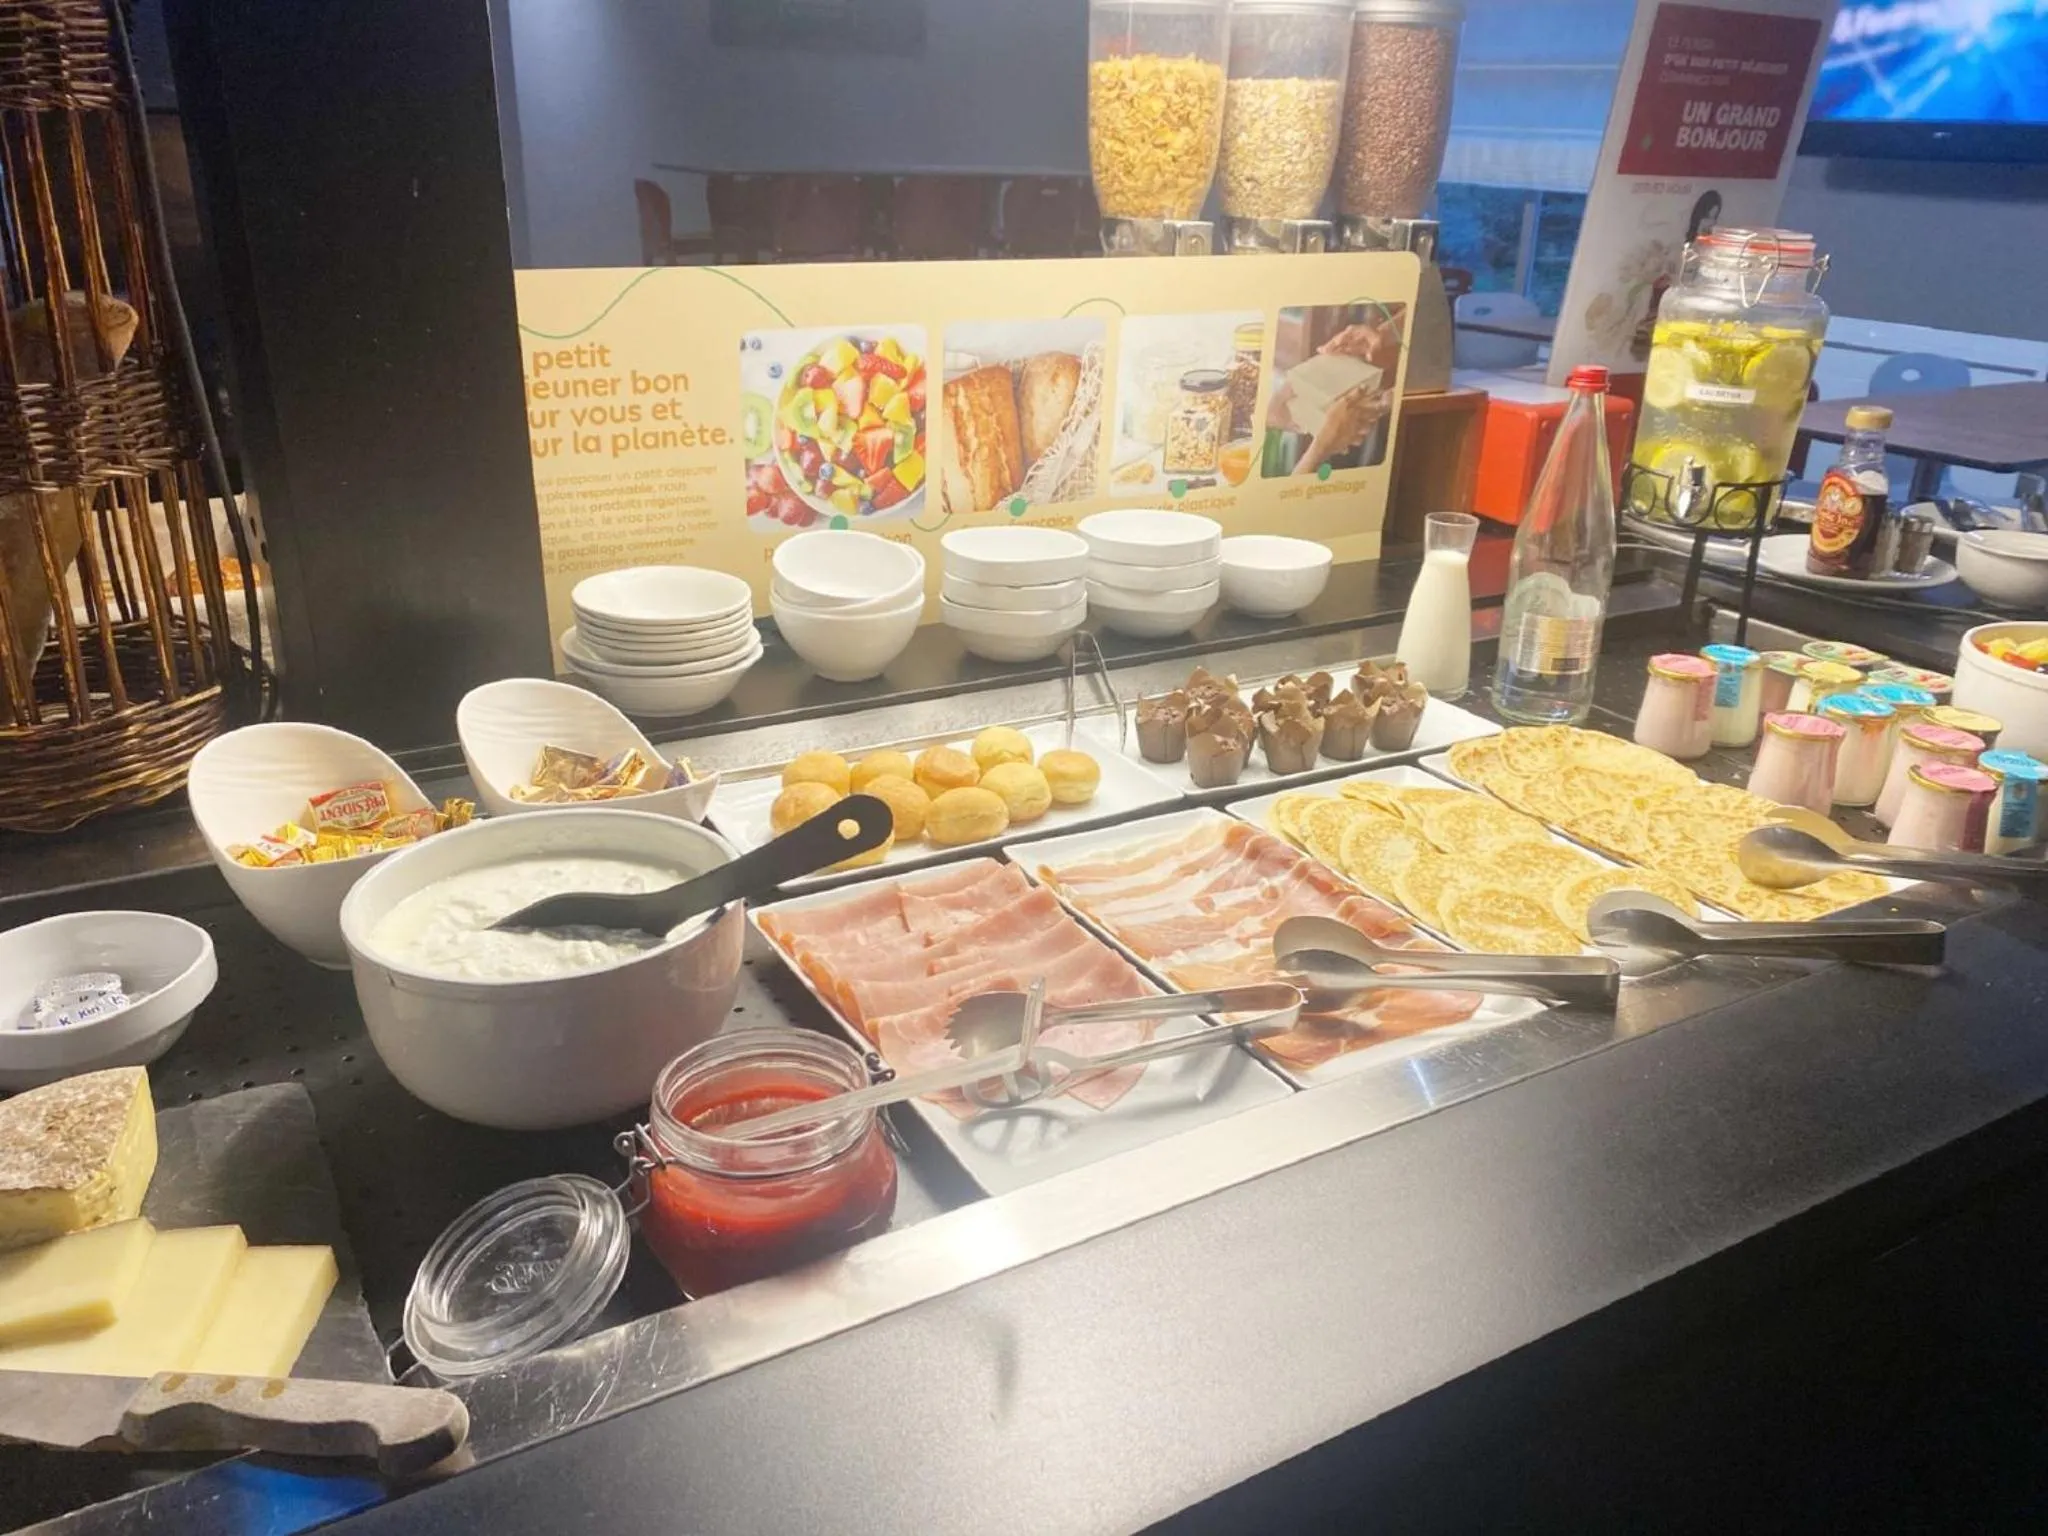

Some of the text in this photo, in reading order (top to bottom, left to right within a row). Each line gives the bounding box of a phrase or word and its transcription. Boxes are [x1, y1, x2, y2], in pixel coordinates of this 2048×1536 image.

[1682, 100, 1781, 128] UN GRAND
[1675, 126, 1768, 150] BONJOUR
[532, 343, 611, 377] petit
[630, 370, 689, 395] bon
[570, 403, 642, 427] vous
[651, 398, 683, 421] et
[573, 430, 601, 454] la
[611, 422, 735, 458] planète.
